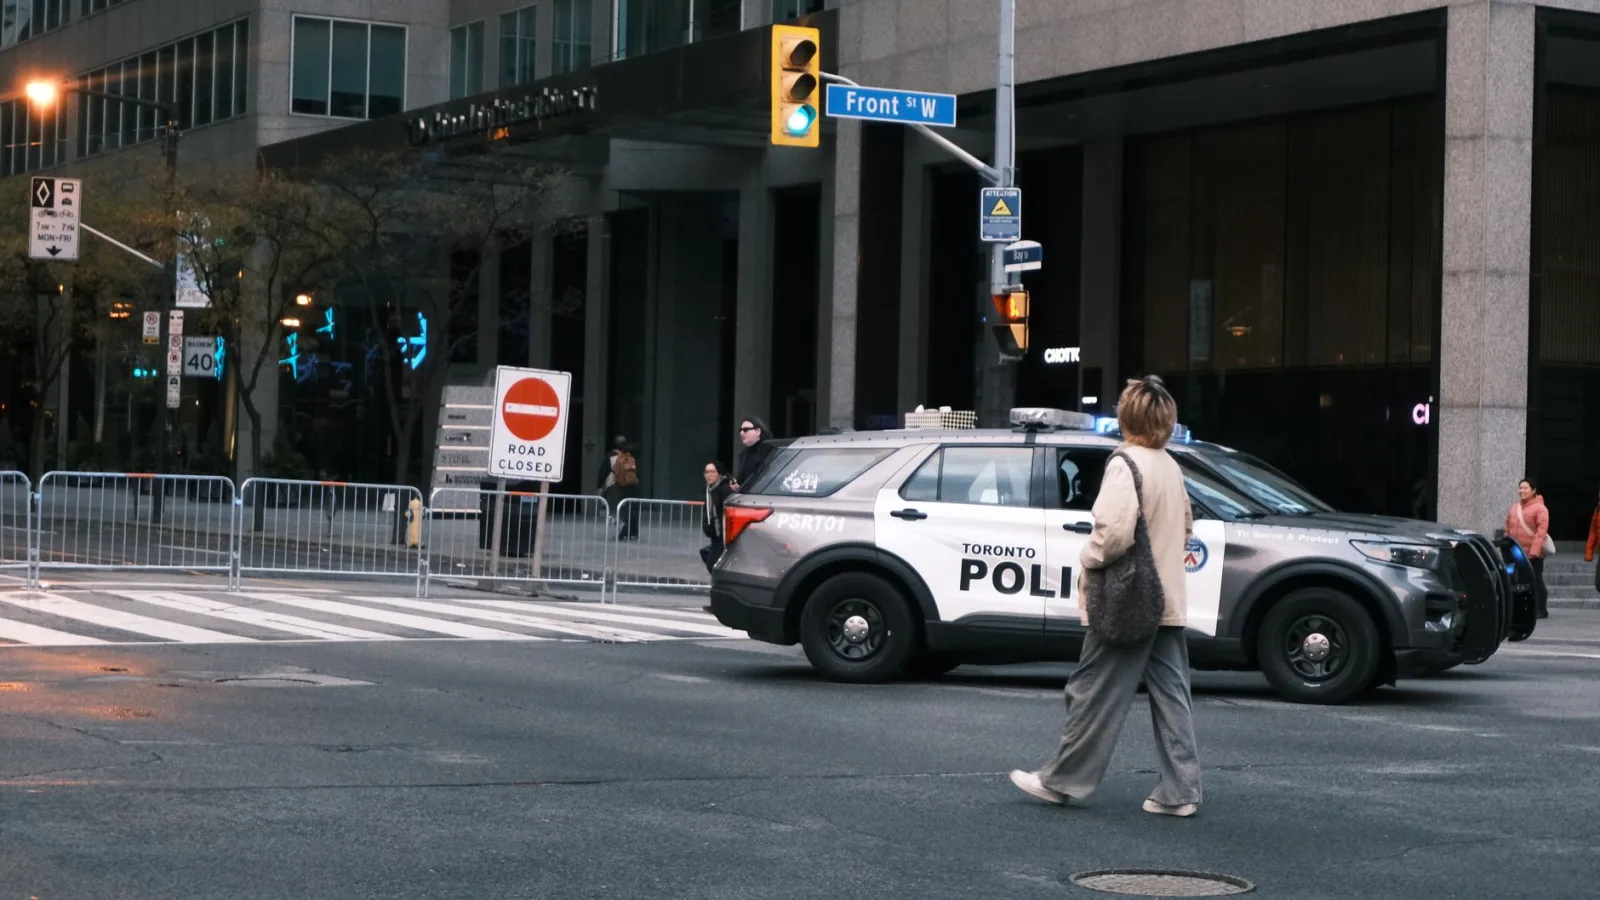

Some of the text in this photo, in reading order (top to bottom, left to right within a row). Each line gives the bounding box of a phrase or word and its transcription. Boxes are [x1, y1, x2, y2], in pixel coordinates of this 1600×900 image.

[846, 91, 936, 119] Front St W
[37, 233, 72, 242] MON-FRI
[1013, 250, 1024, 262] Bay
[187, 353, 213, 371] 40
[508, 444, 546, 457] ROAD
[498, 459, 553, 473] CLOSED
[777, 514, 846, 532] PSRT01
[1236, 530, 1340, 544] To Serve & Protect
[962, 543, 1036, 558] TORONTO
[959, 558, 1081, 598] POLI
